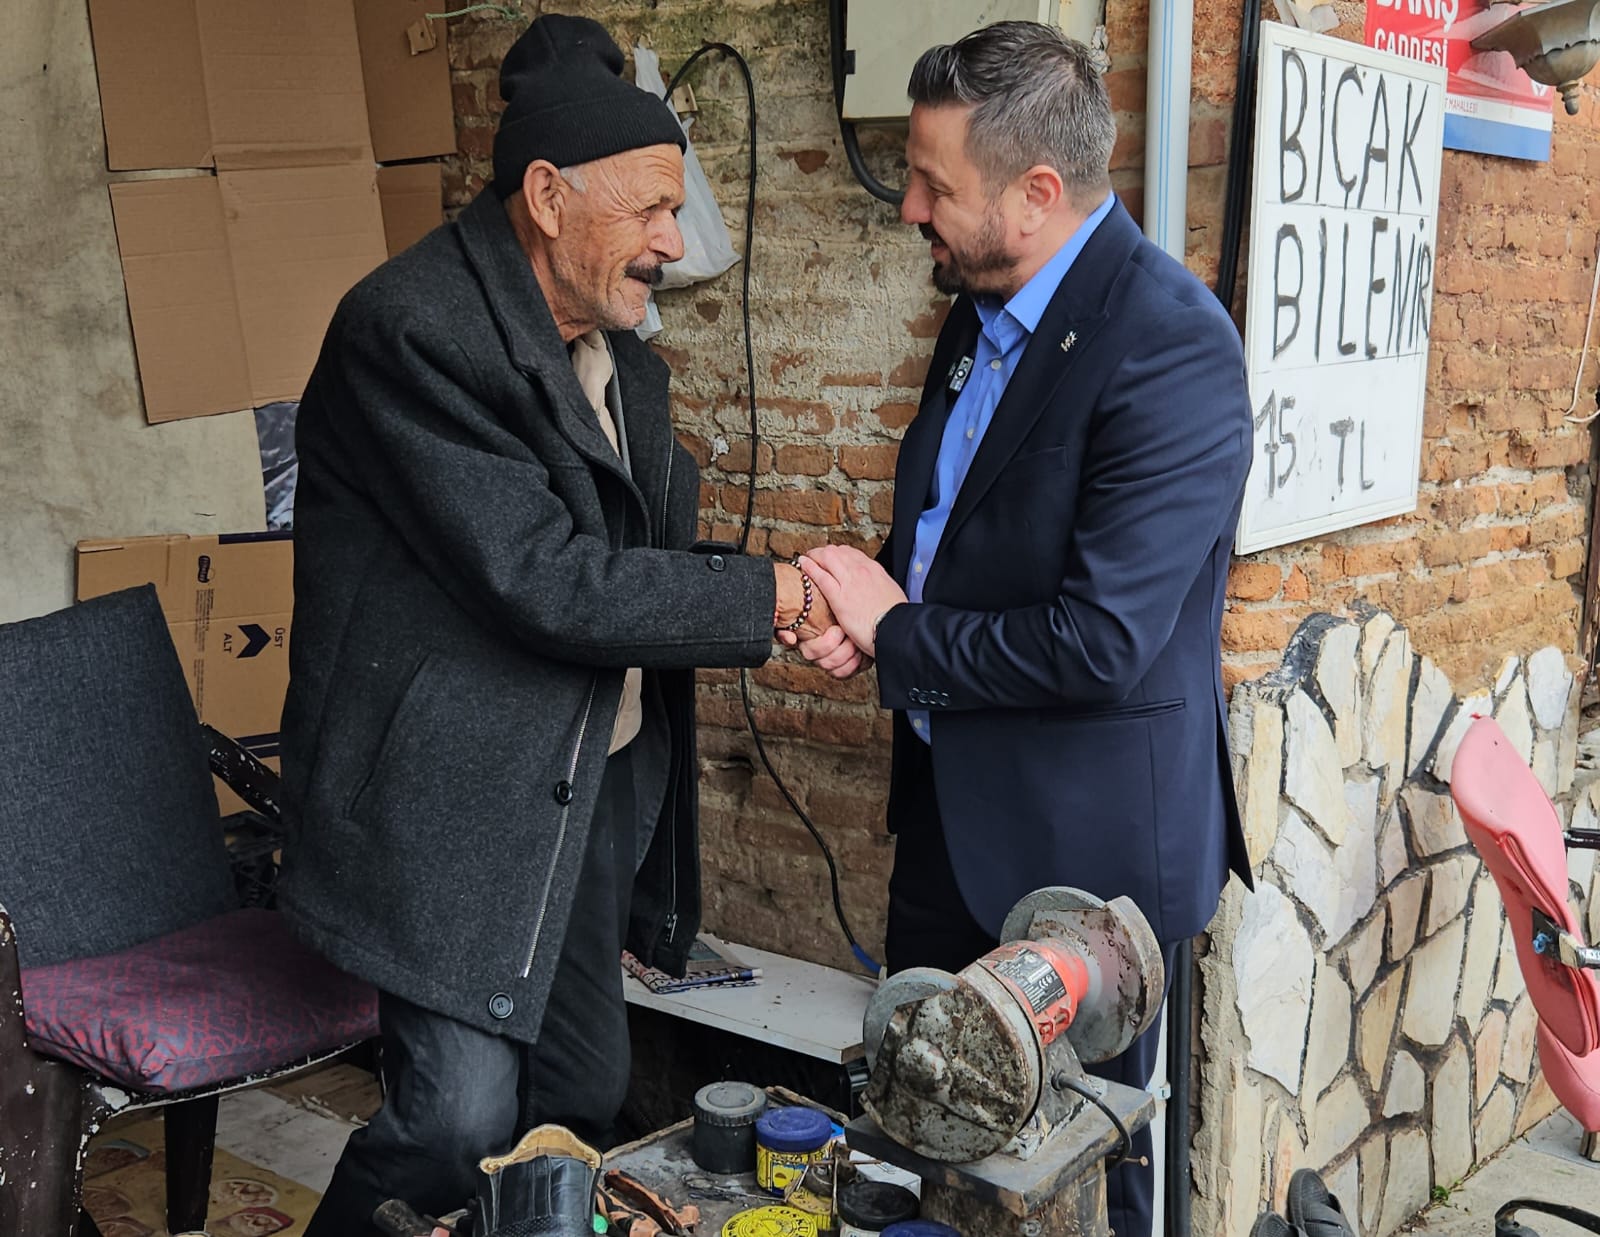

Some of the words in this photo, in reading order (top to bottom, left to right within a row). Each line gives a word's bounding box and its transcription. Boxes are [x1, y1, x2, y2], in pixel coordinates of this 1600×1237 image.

[1280, 49, 1429, 215] BIÇAK
[1329, 416, 1375, 493] TL
[223, 632, 232, 654] ALT
